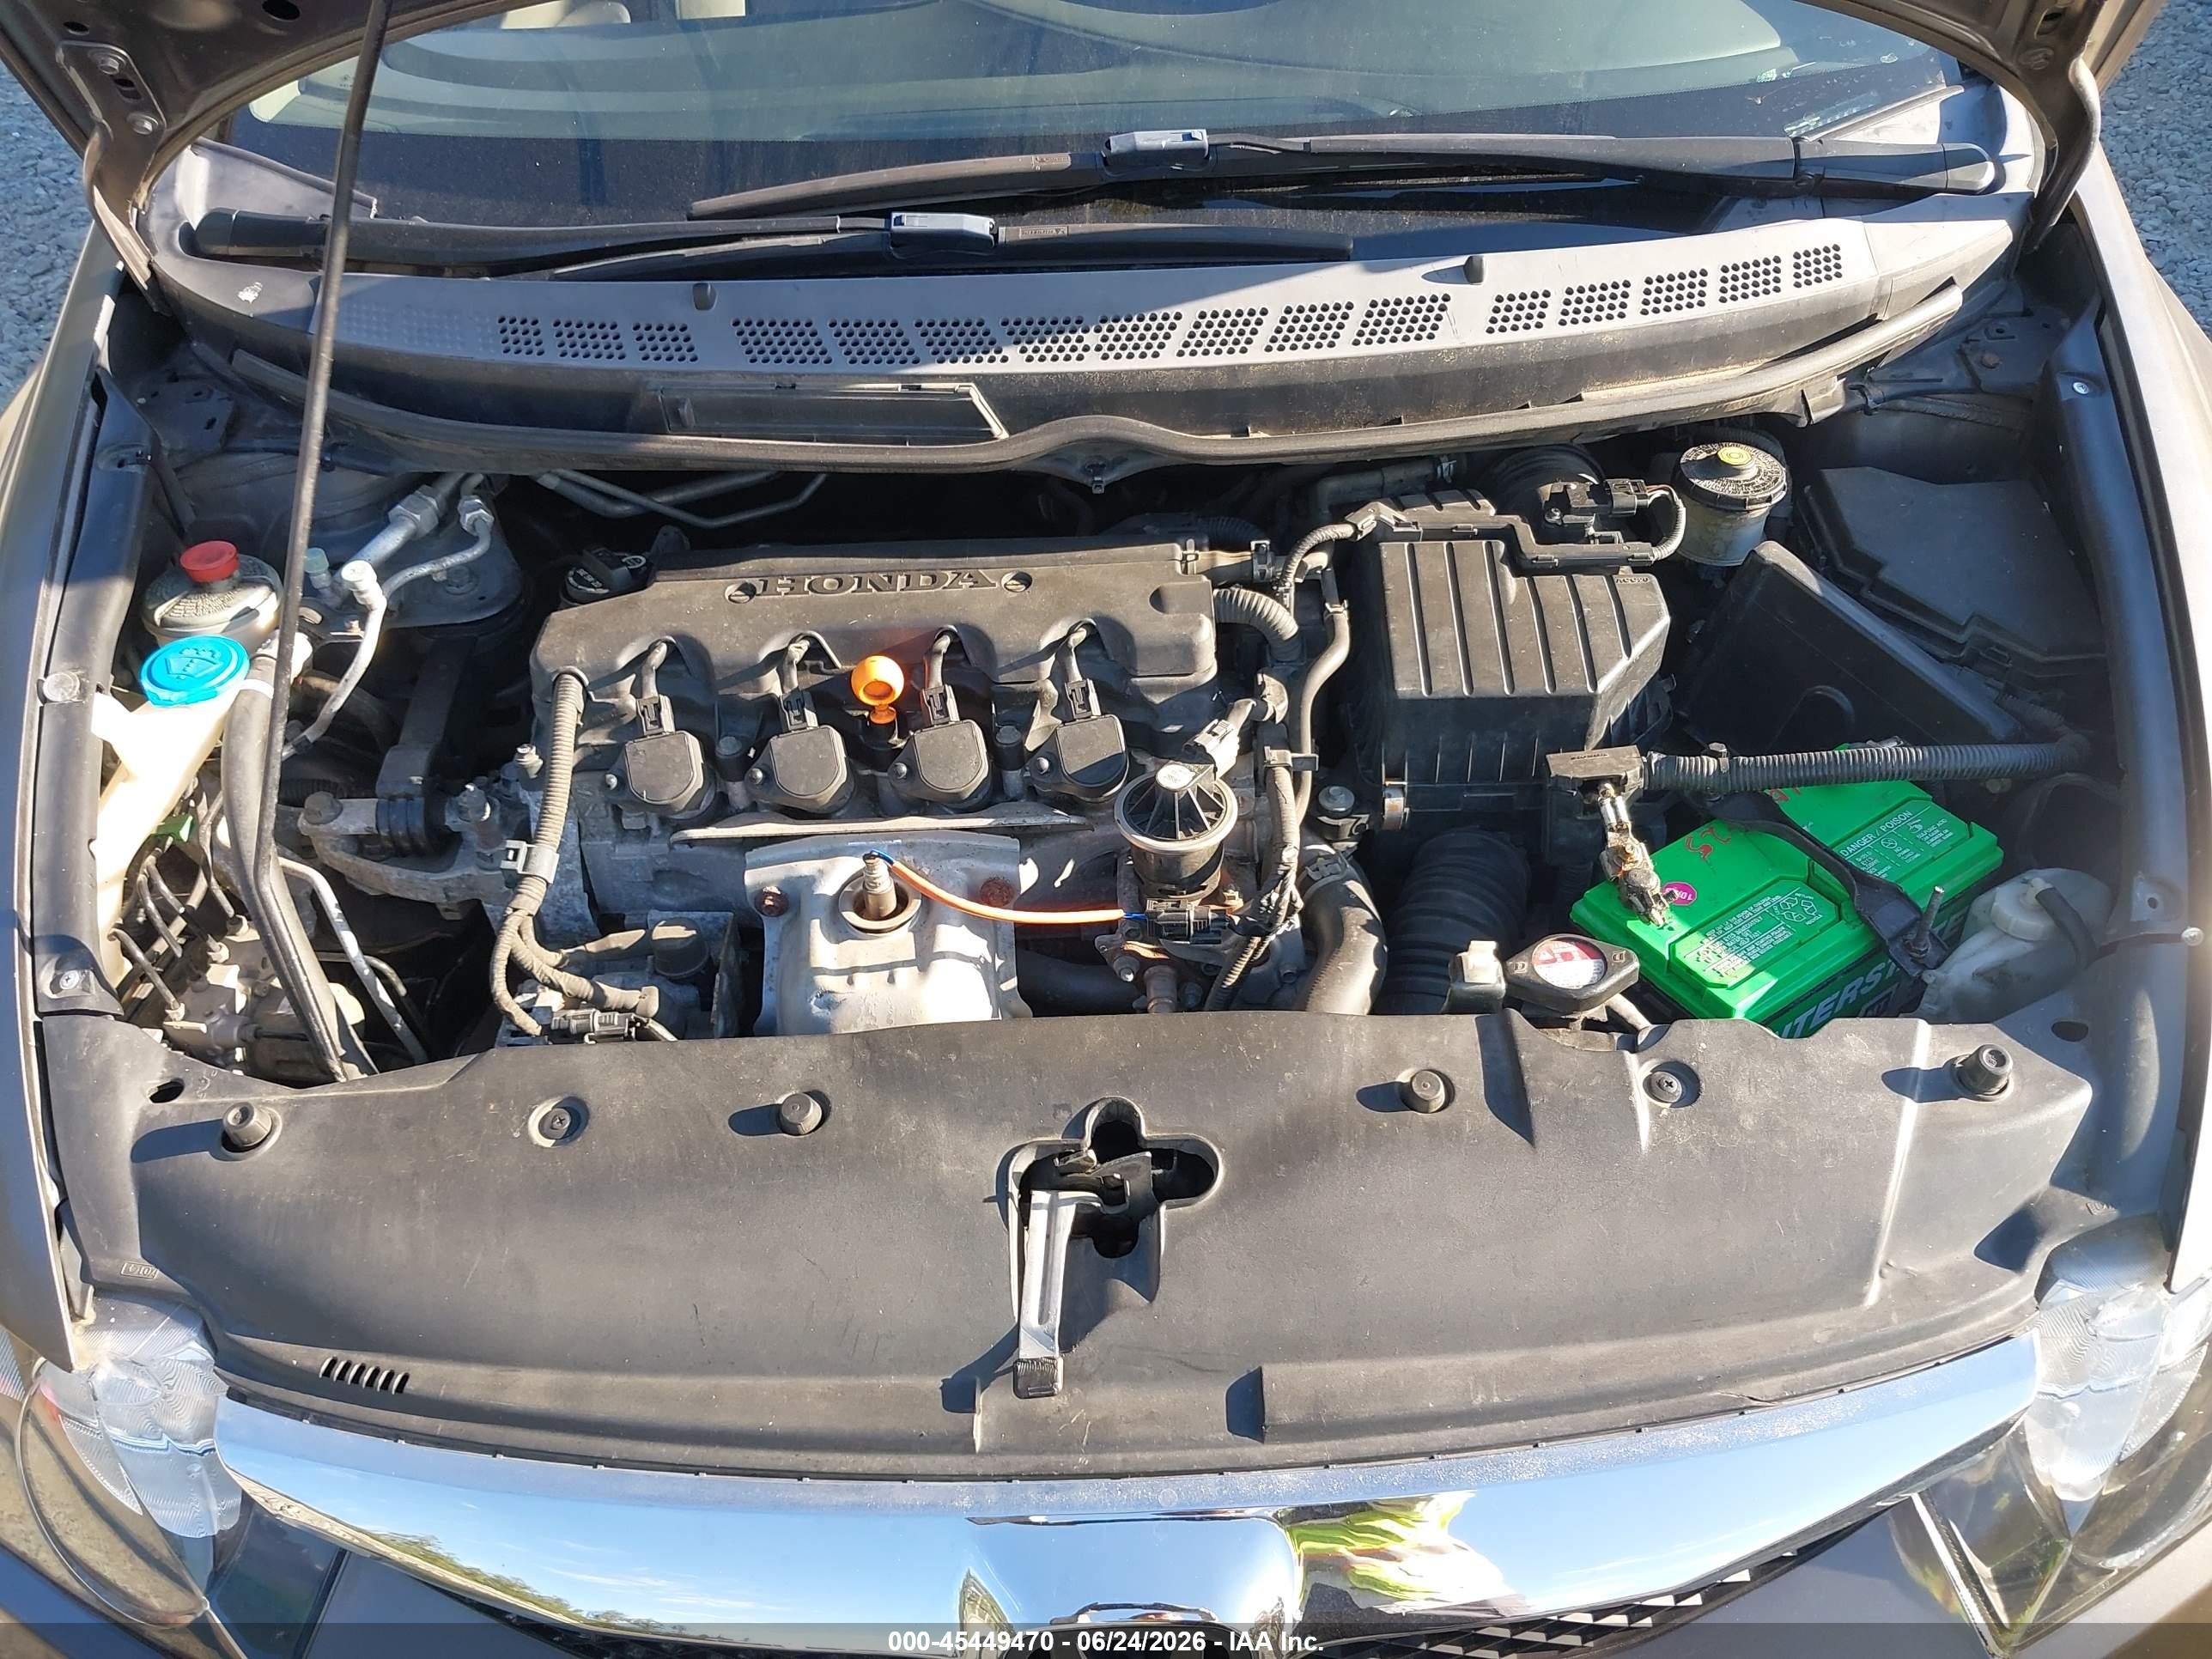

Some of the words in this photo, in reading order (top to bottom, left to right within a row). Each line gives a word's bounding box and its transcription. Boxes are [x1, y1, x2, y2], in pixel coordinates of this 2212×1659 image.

[759, 569, 998, 599] HONDA
[1839, 833, 1876, 856] DANGER
[1881, 811, 1912, 832] POISON
